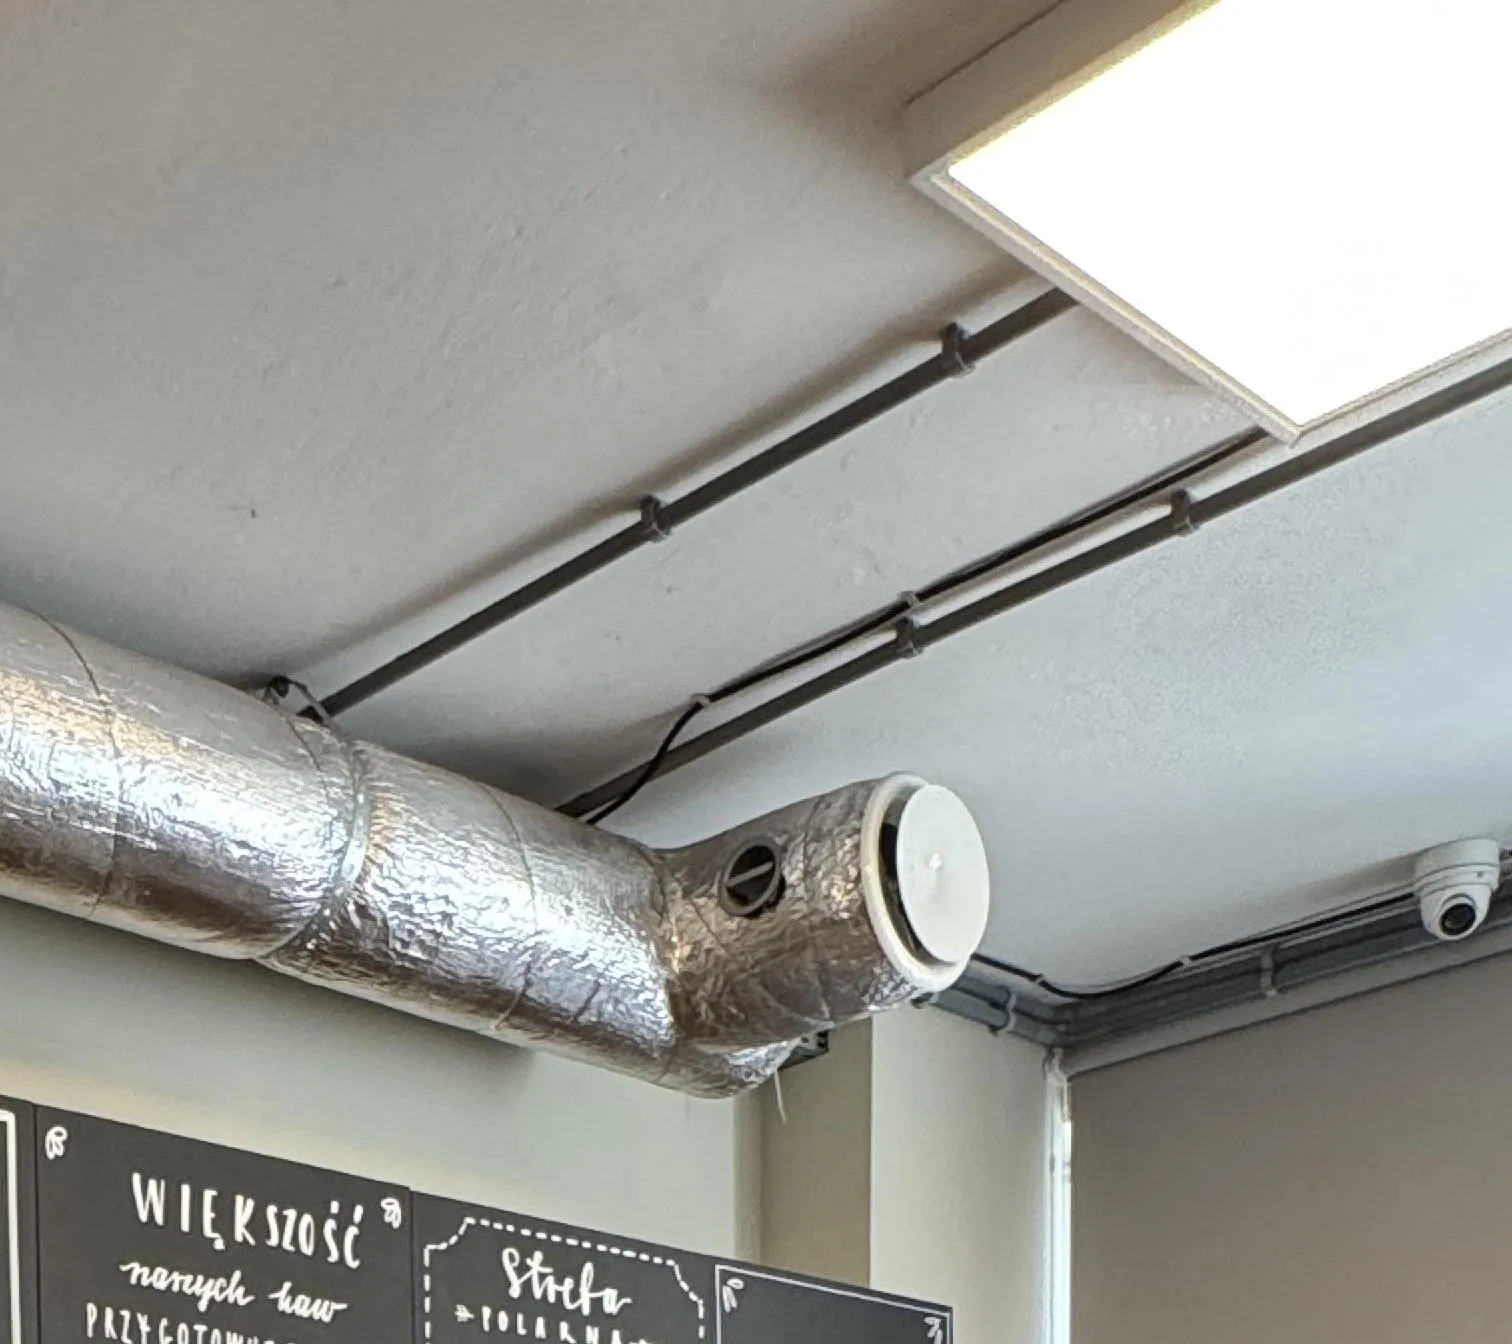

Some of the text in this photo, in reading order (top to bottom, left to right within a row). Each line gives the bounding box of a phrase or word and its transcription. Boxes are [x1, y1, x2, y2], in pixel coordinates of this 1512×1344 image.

[132, 1172, 364, 1268] WIĘKSZOŚĆ
[268, 1281, 348, 1323] kaw
[501, 1247, 633, 1316] Strefa
